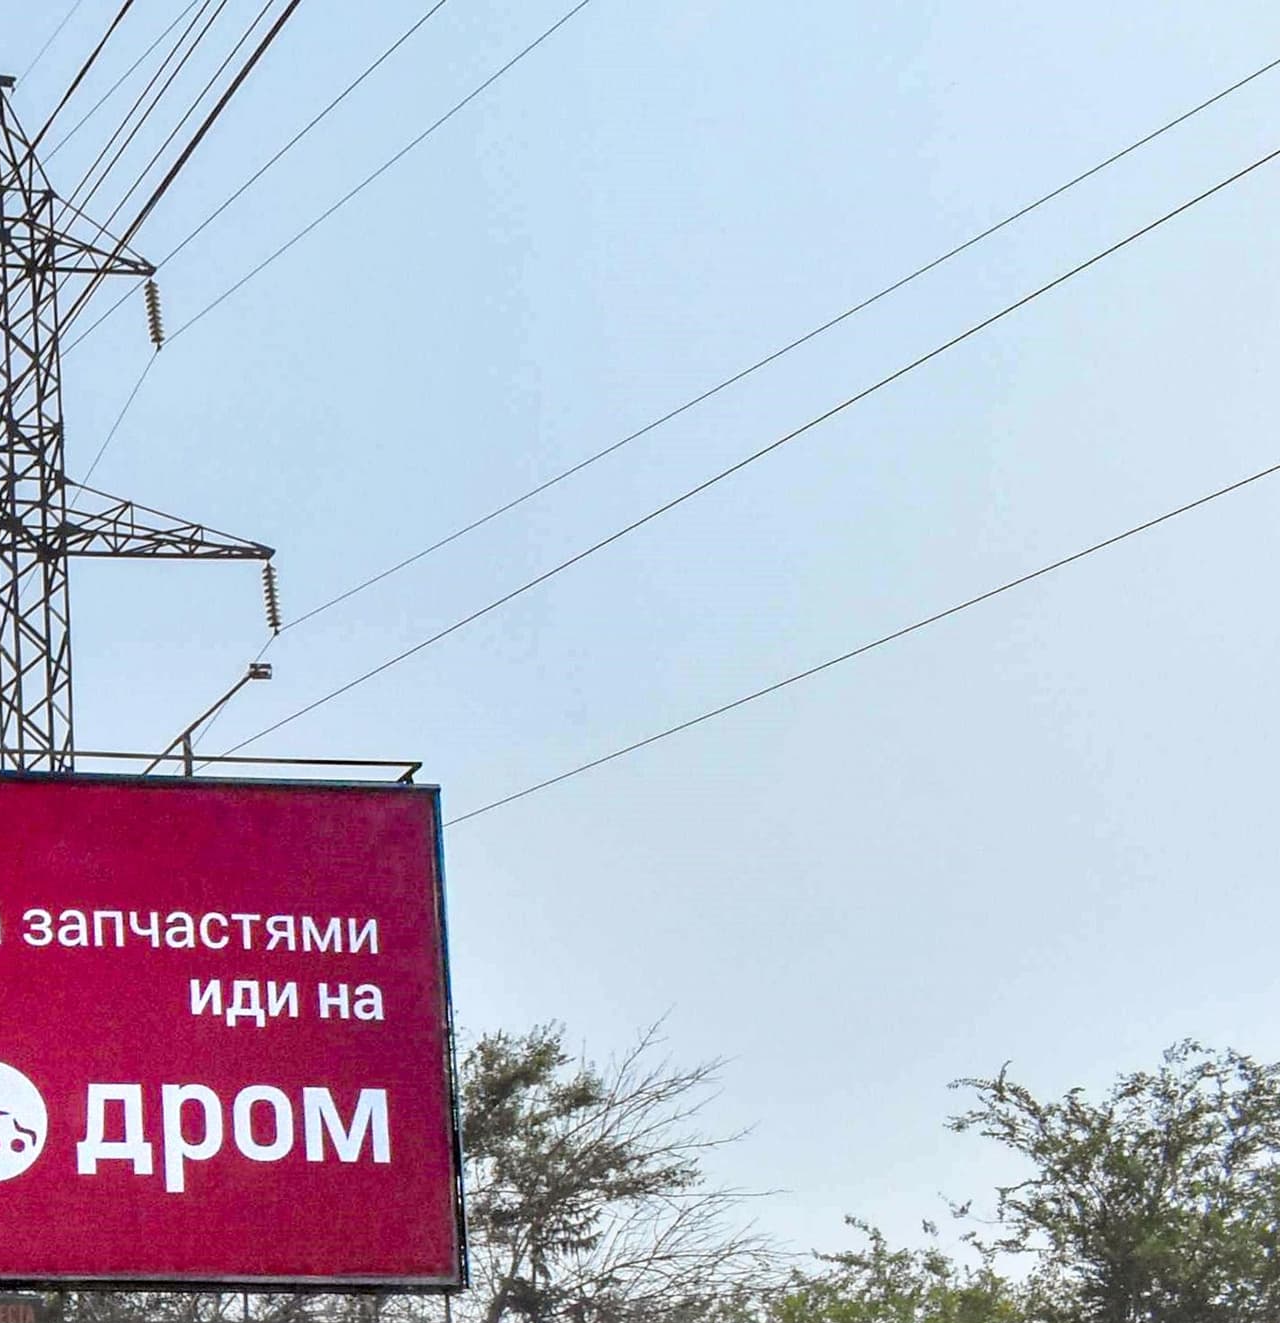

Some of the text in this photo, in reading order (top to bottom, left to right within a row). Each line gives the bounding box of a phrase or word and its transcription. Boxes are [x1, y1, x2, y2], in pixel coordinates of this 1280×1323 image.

[22, 906, 380, 955] запчастями
[188, 977, 385, 1028] иди на
[76, 1083, 391, 1193] дром
